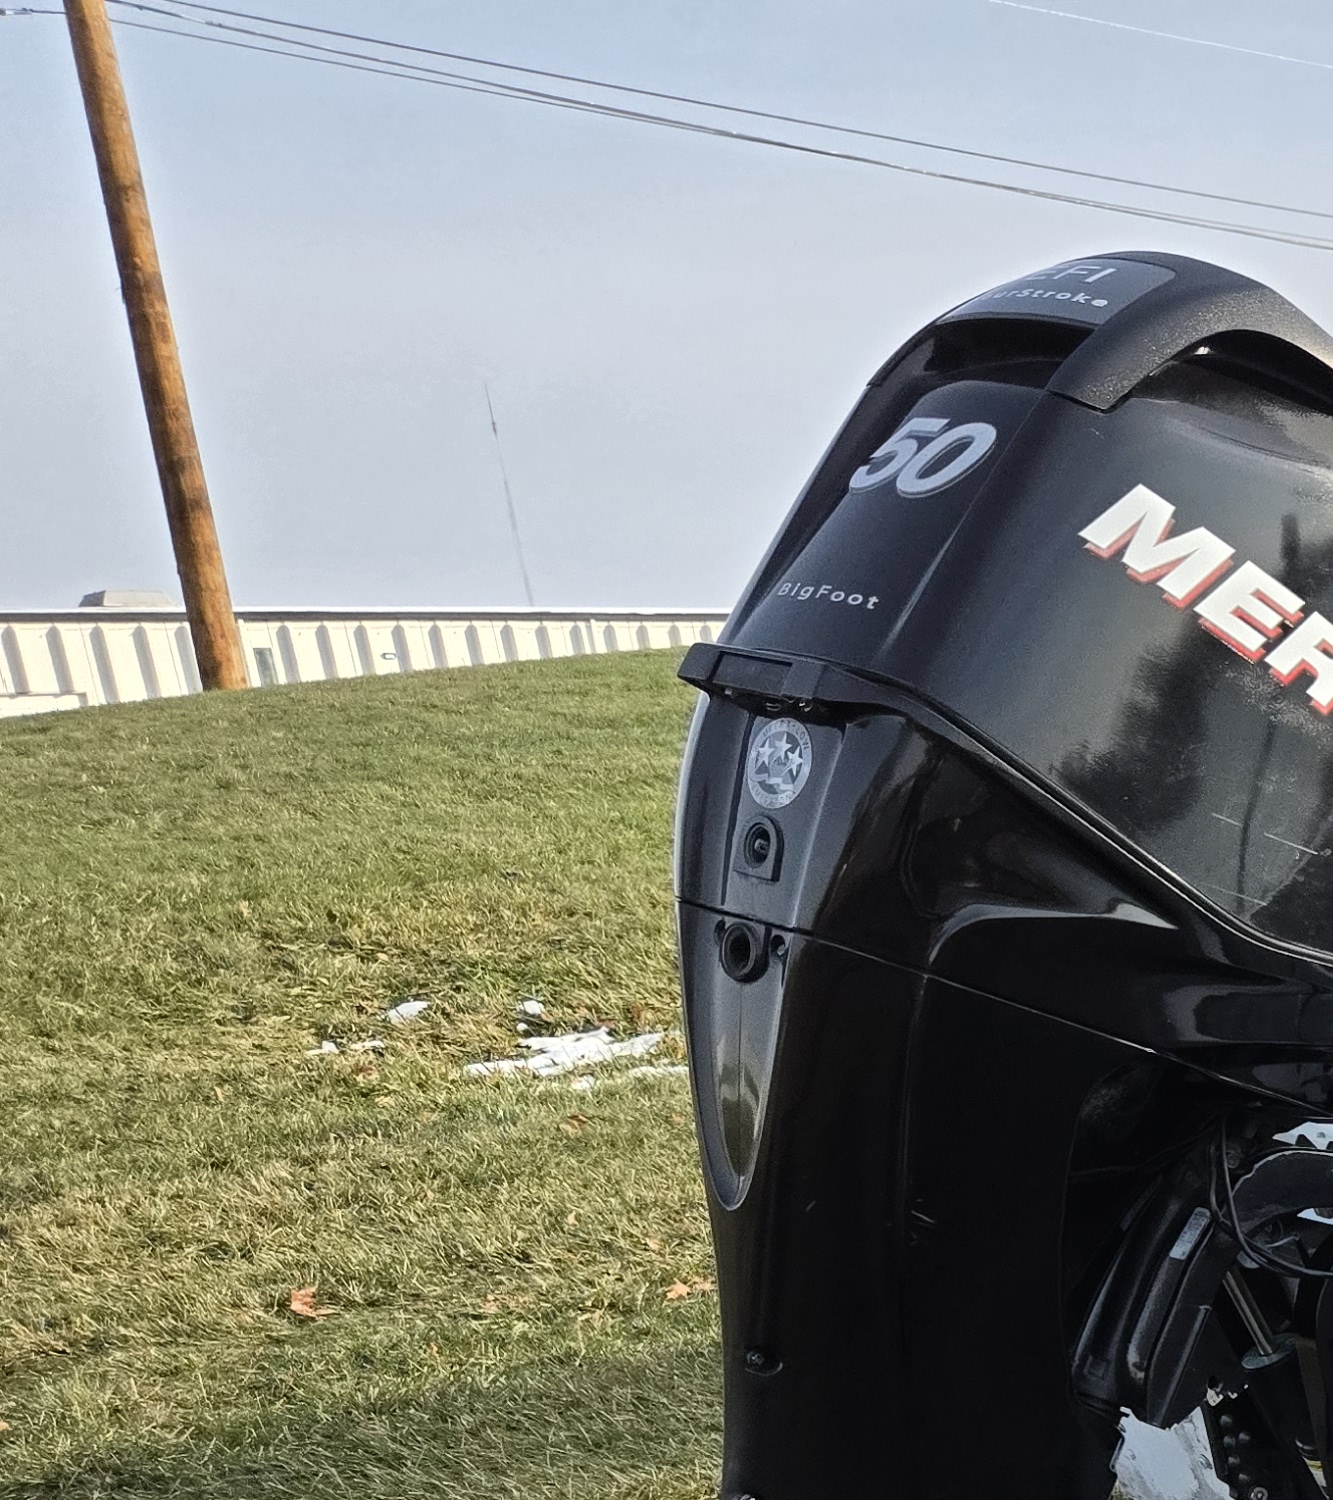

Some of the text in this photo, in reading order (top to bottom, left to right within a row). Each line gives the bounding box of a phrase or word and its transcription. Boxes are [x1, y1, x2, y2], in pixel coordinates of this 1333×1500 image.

[1025, 265, 1118, 284] EFI
[849, 417, 998, 499] 50
[777, 581, 881, 610] BigFoot
